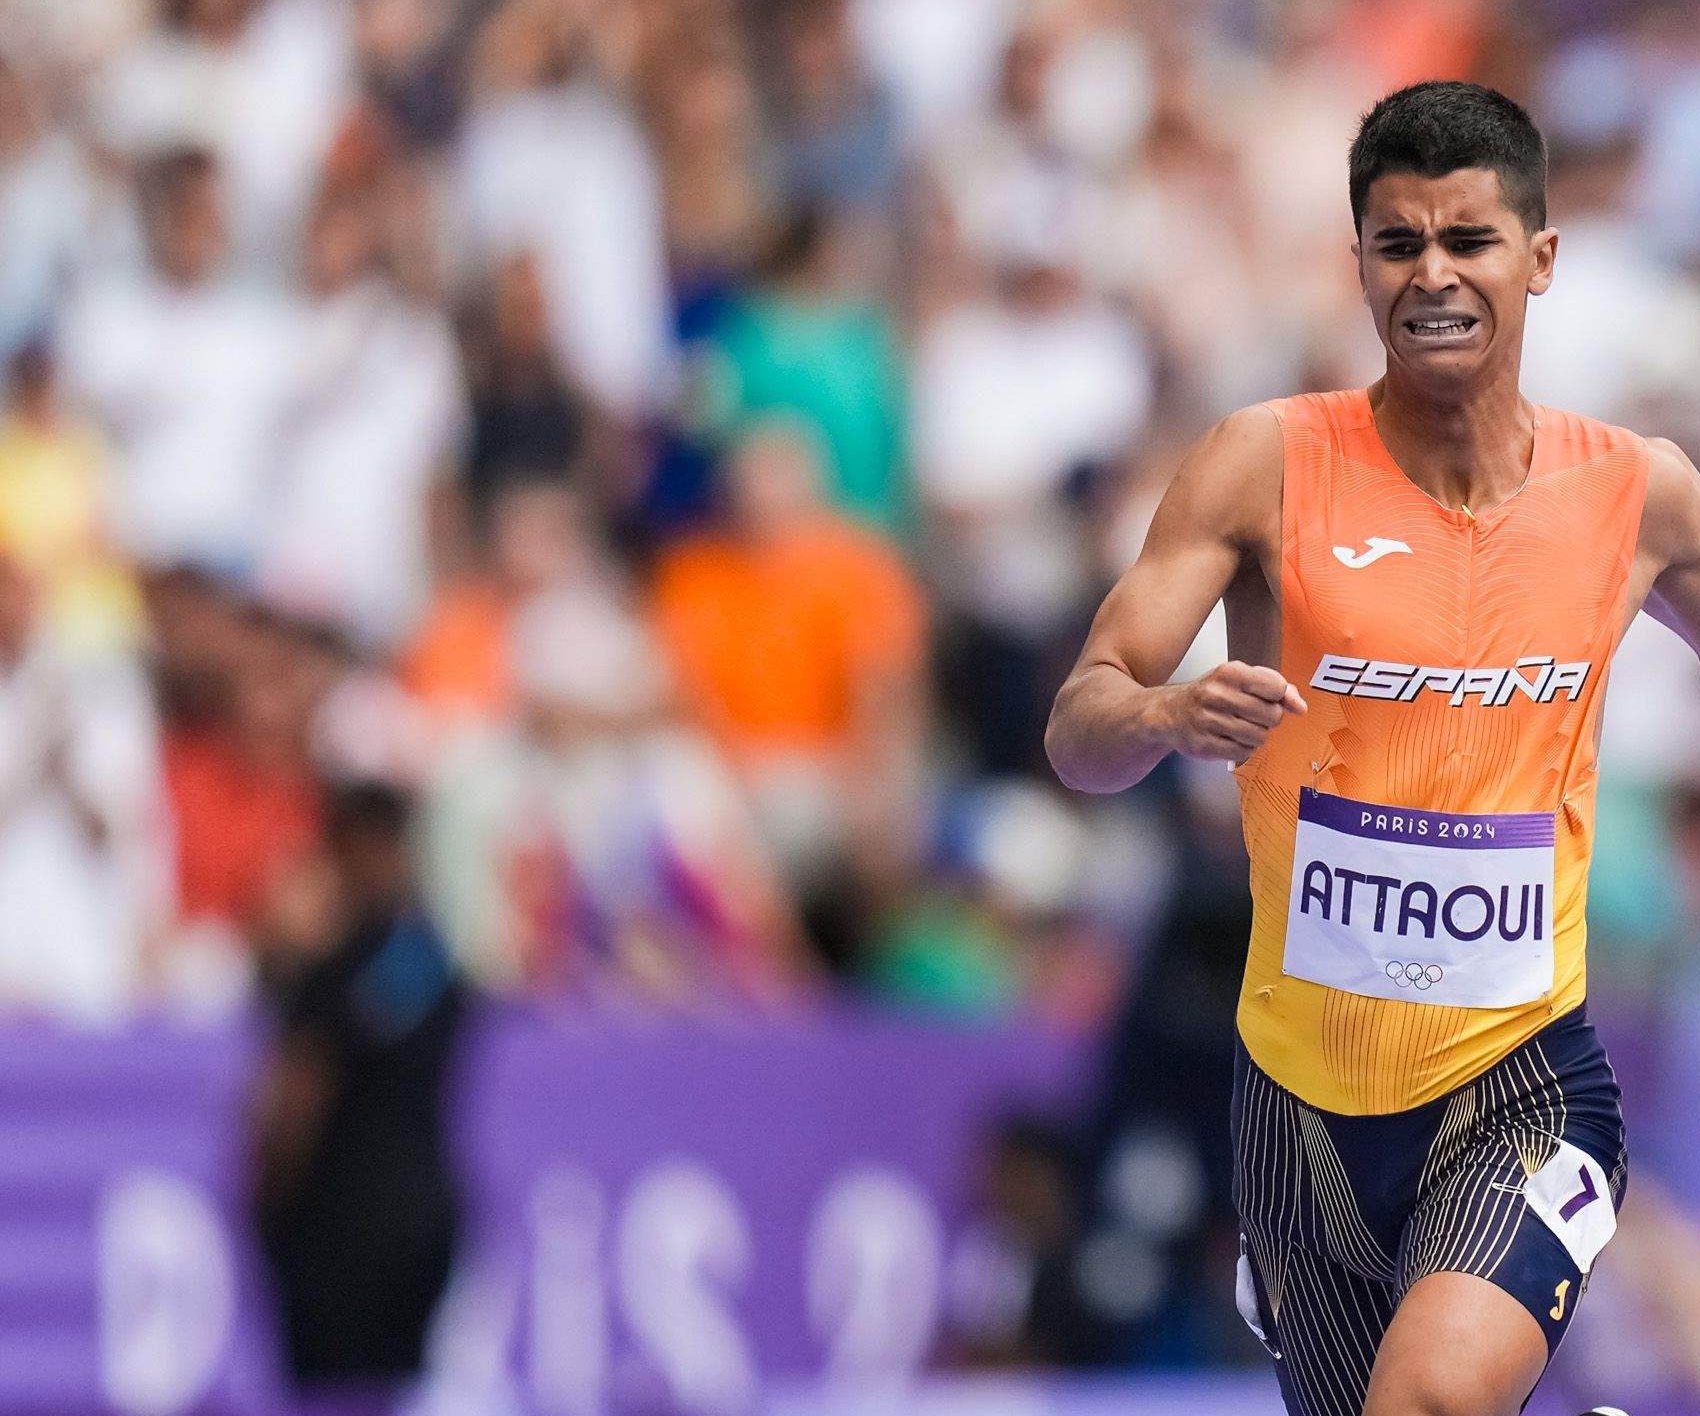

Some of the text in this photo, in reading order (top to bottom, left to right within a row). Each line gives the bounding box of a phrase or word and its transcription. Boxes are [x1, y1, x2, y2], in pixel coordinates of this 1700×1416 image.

[1309, 653, 1592, 708] ESPAÑA
[1437, 822, 1496, 839] 2024
[1299, 859, 1544, 942] ATTAOUI
[1558, 1163, 1600, 1224] 7
